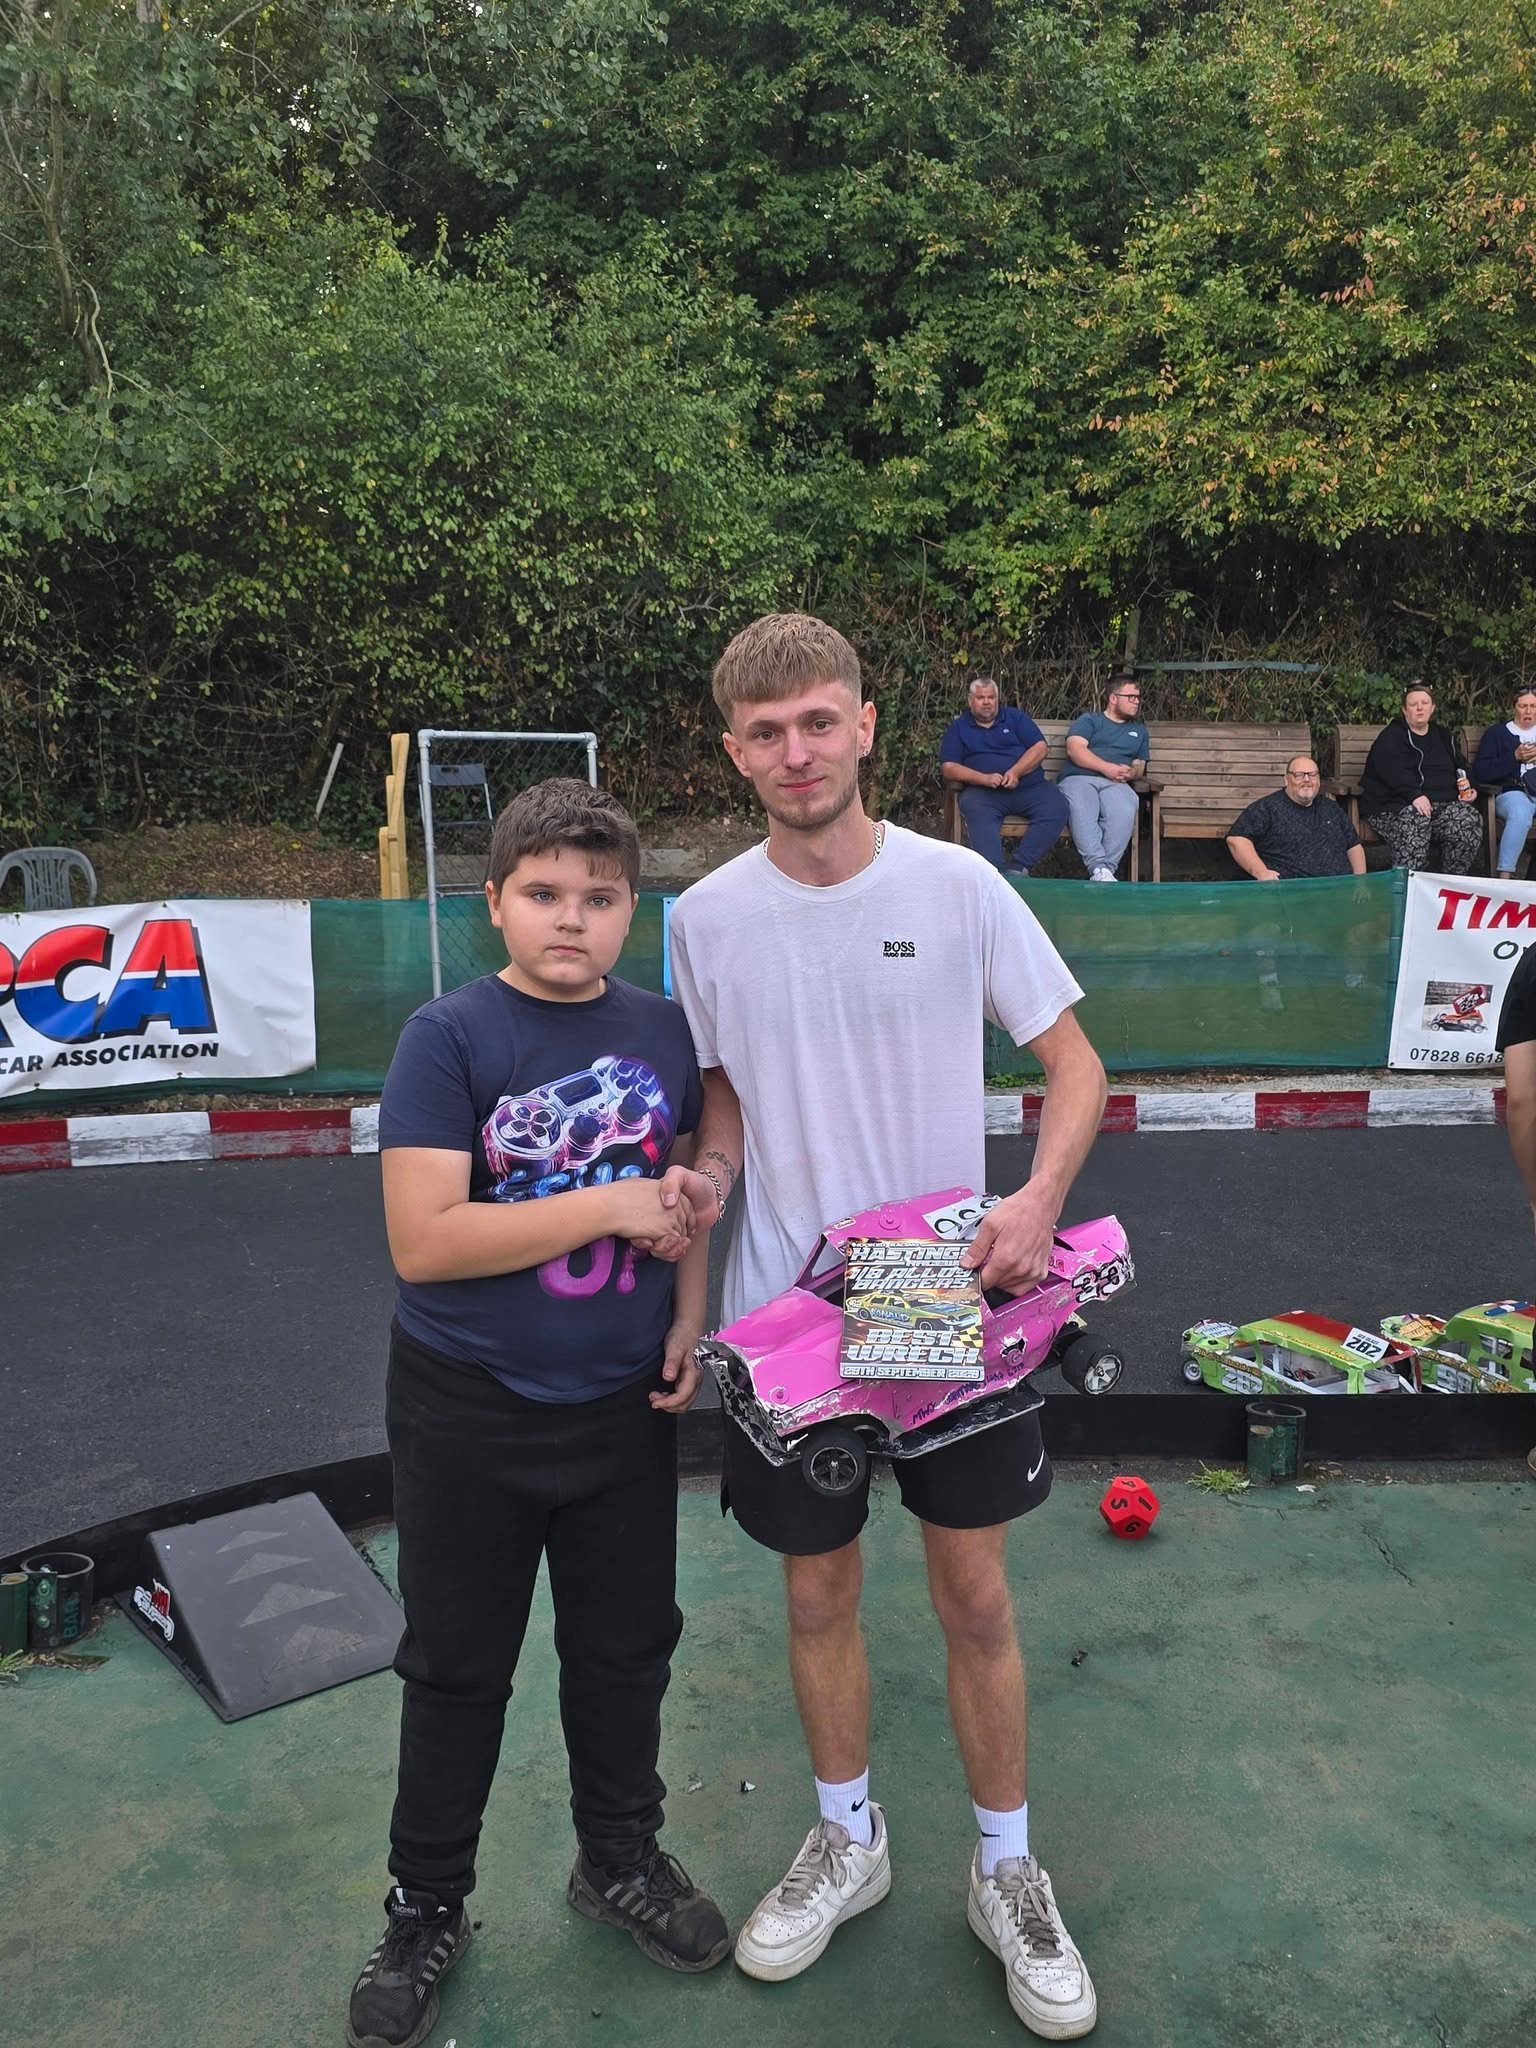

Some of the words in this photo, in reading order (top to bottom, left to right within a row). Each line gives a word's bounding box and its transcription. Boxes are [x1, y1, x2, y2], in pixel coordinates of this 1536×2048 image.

[883, 941, 915, 952] BOSS
[0, 919, 218, 1047] CA
[52, 1043, 219, 1068] ASSOCIATION
[1410, 1048, 1460, 1063] 07828
[884, 1267, 974, 1280] ALLOY
[851, 1278, 974, 1291] BANGERS
[864, 1328, 959, 1346] BEST
[877, 1367, 946, 1378] SEPTEMBER
